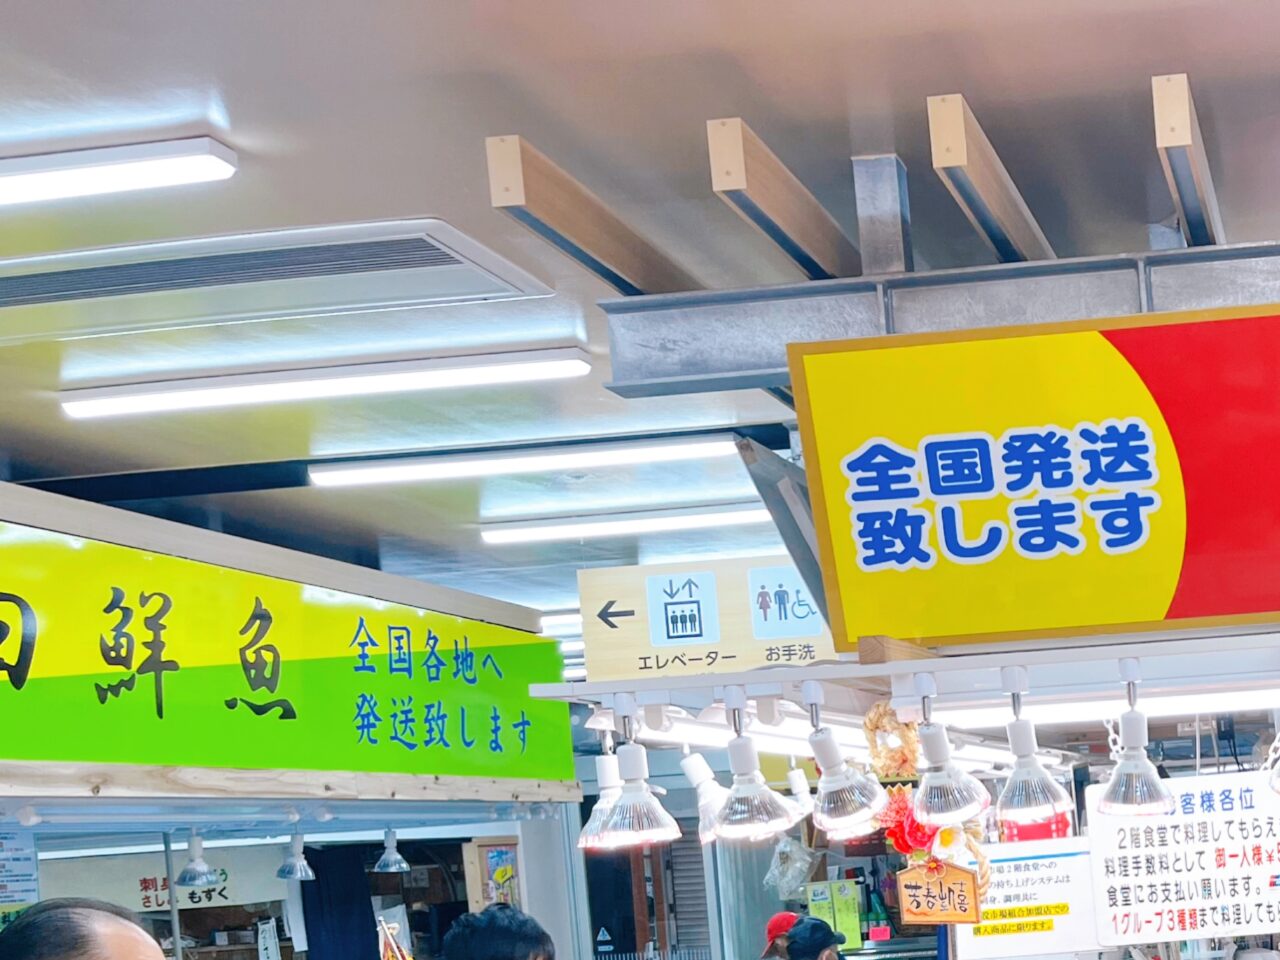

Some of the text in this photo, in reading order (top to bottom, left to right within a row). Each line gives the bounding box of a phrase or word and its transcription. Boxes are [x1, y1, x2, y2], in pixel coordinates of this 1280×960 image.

[844, 419, 1156, 505] 全国発送
[854, 490, 1160, 569] 致します
[349, 616, 503, 685] 全国各地へ
[638, 643, 816, 671] エレベーター お手洗
[353, 693, 532, 755] 発送致します
[188, 886, 229, 904] もずく
[1104, 851, 1207, 878] 料理手数料として
